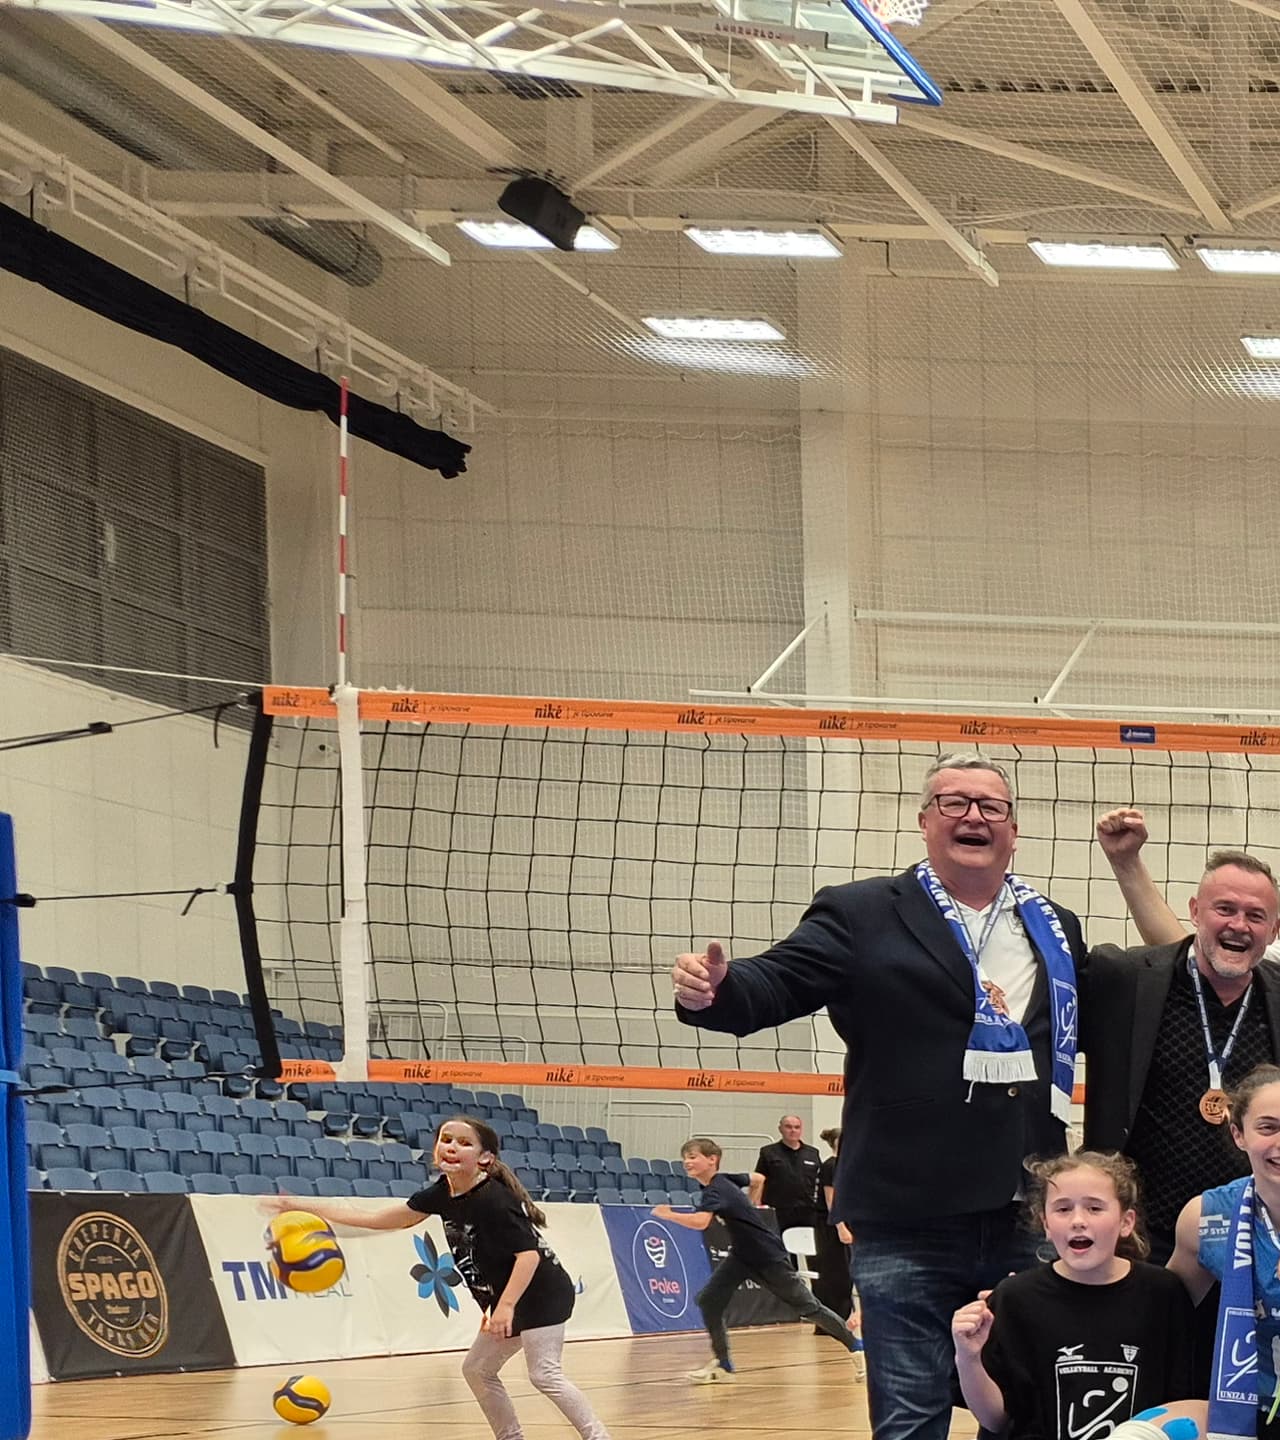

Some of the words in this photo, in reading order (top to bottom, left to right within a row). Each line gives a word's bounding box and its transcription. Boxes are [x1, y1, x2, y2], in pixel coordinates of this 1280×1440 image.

[404, 1064, 431, 1078] niké
[546, 1069, 573, 1083] niké
[687, 1073, 714, 1087] niké
[68, 1271, 157, 1300] SPAGO
[649, 1278, 681, 1295] Poke
